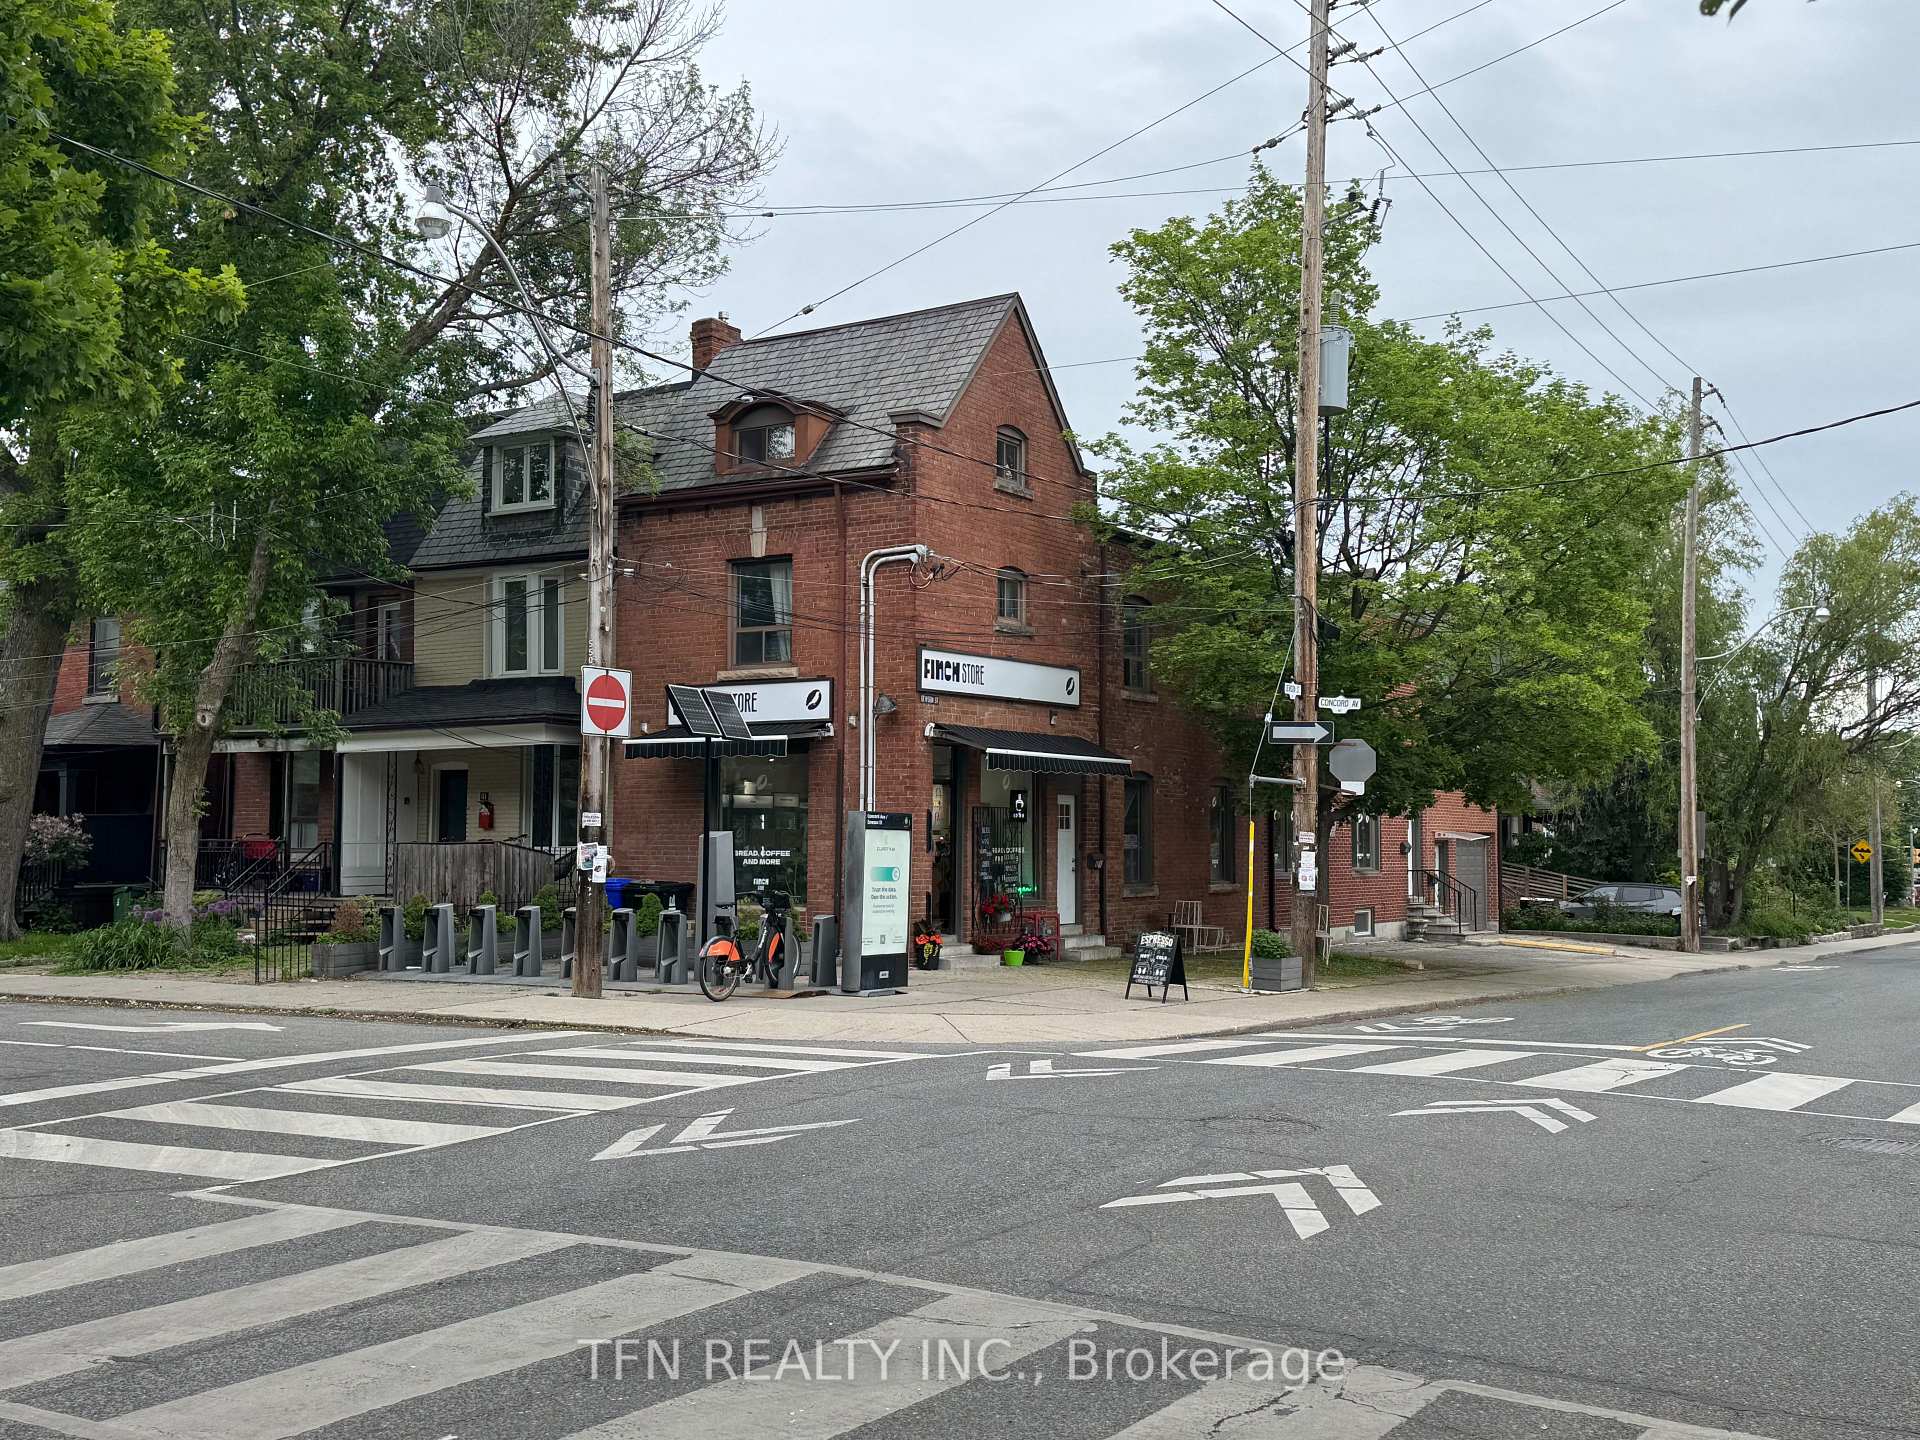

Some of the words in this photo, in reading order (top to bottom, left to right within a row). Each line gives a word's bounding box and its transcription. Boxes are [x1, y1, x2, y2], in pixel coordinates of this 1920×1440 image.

[924, 658, 960, 682] FINCH
[962, 664, 984, 686] STORE
[732, 692, 758, 712] TORE
[1320, 698, 1348, 708] CONCORD
[1140, 935, 1173, 947] ESPRESSO
